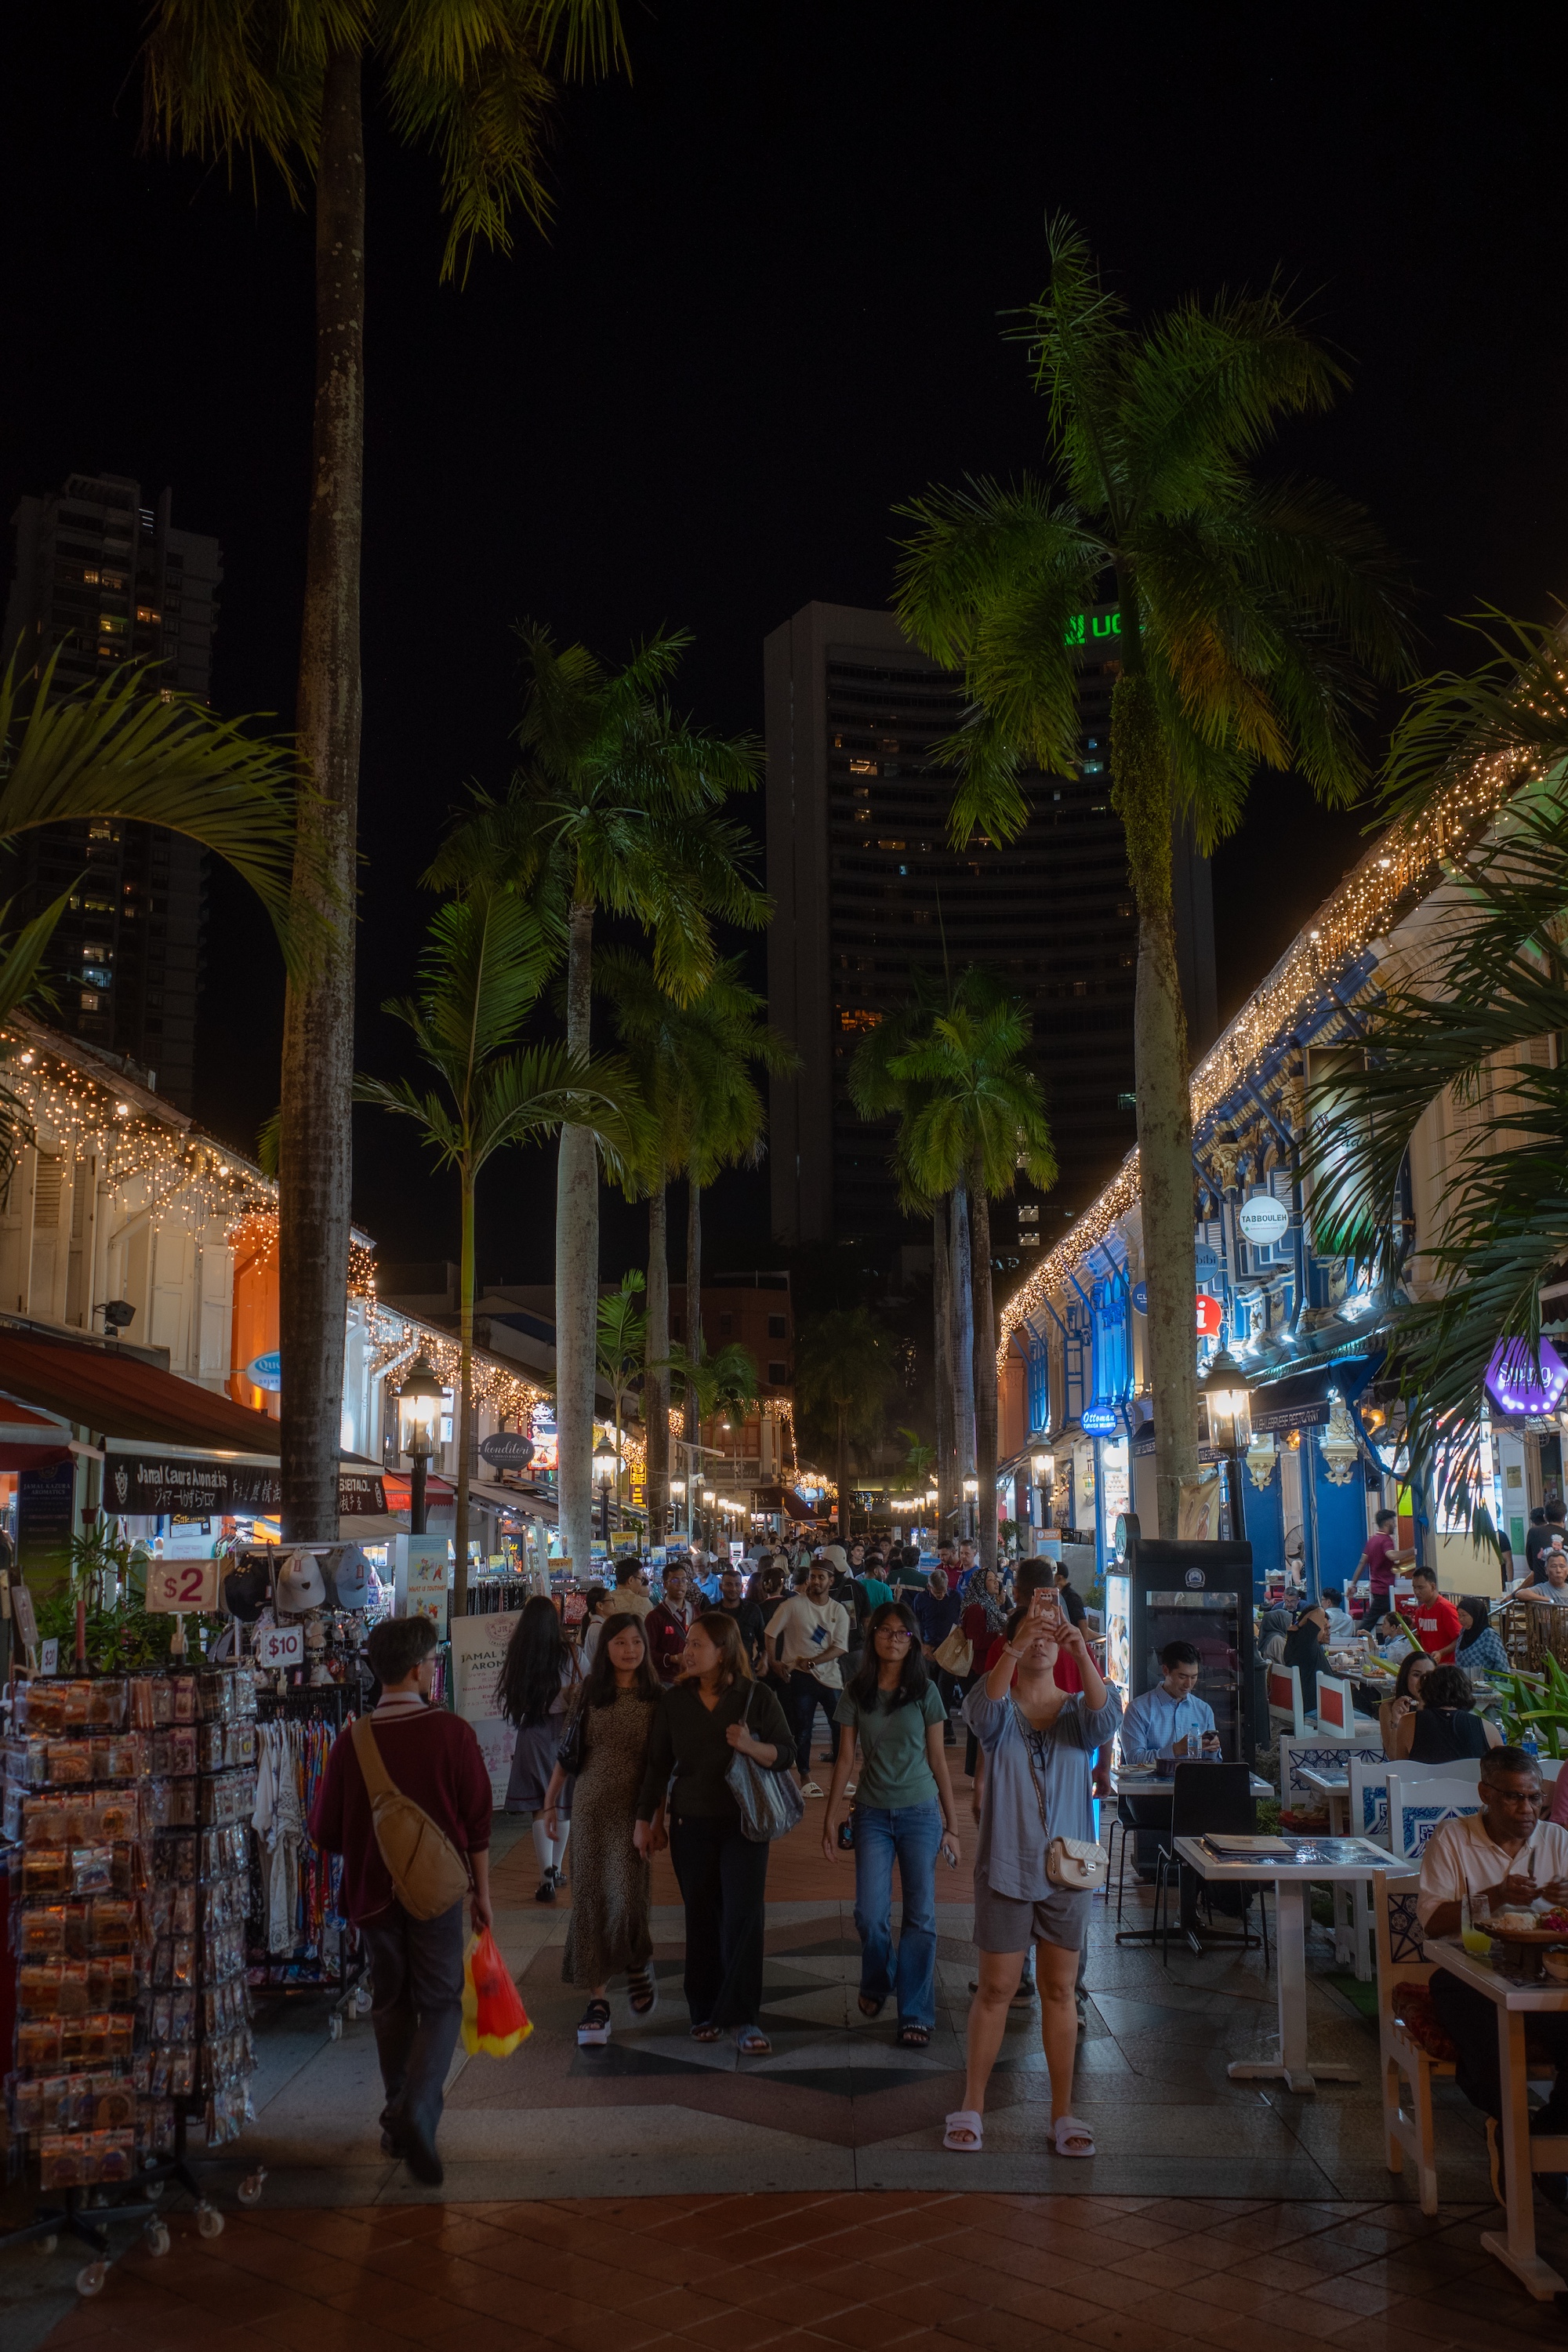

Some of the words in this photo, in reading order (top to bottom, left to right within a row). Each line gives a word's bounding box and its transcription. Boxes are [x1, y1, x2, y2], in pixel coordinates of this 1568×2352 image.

[1241, 1214, 1287, 1223] TABBOULEH
[1196, 1254, 1216, 1265] bibi
[1083, 1411, 1115, 1423] Ottoman
[484, 1440, 529, 1454] konditori
[172, 1514, 189, 1525] Silk
[163, 1567, 204, 1602] $2
[268, 1635, 298, 1658] $10
[461, 1651, 497, 1663] JAMAL
